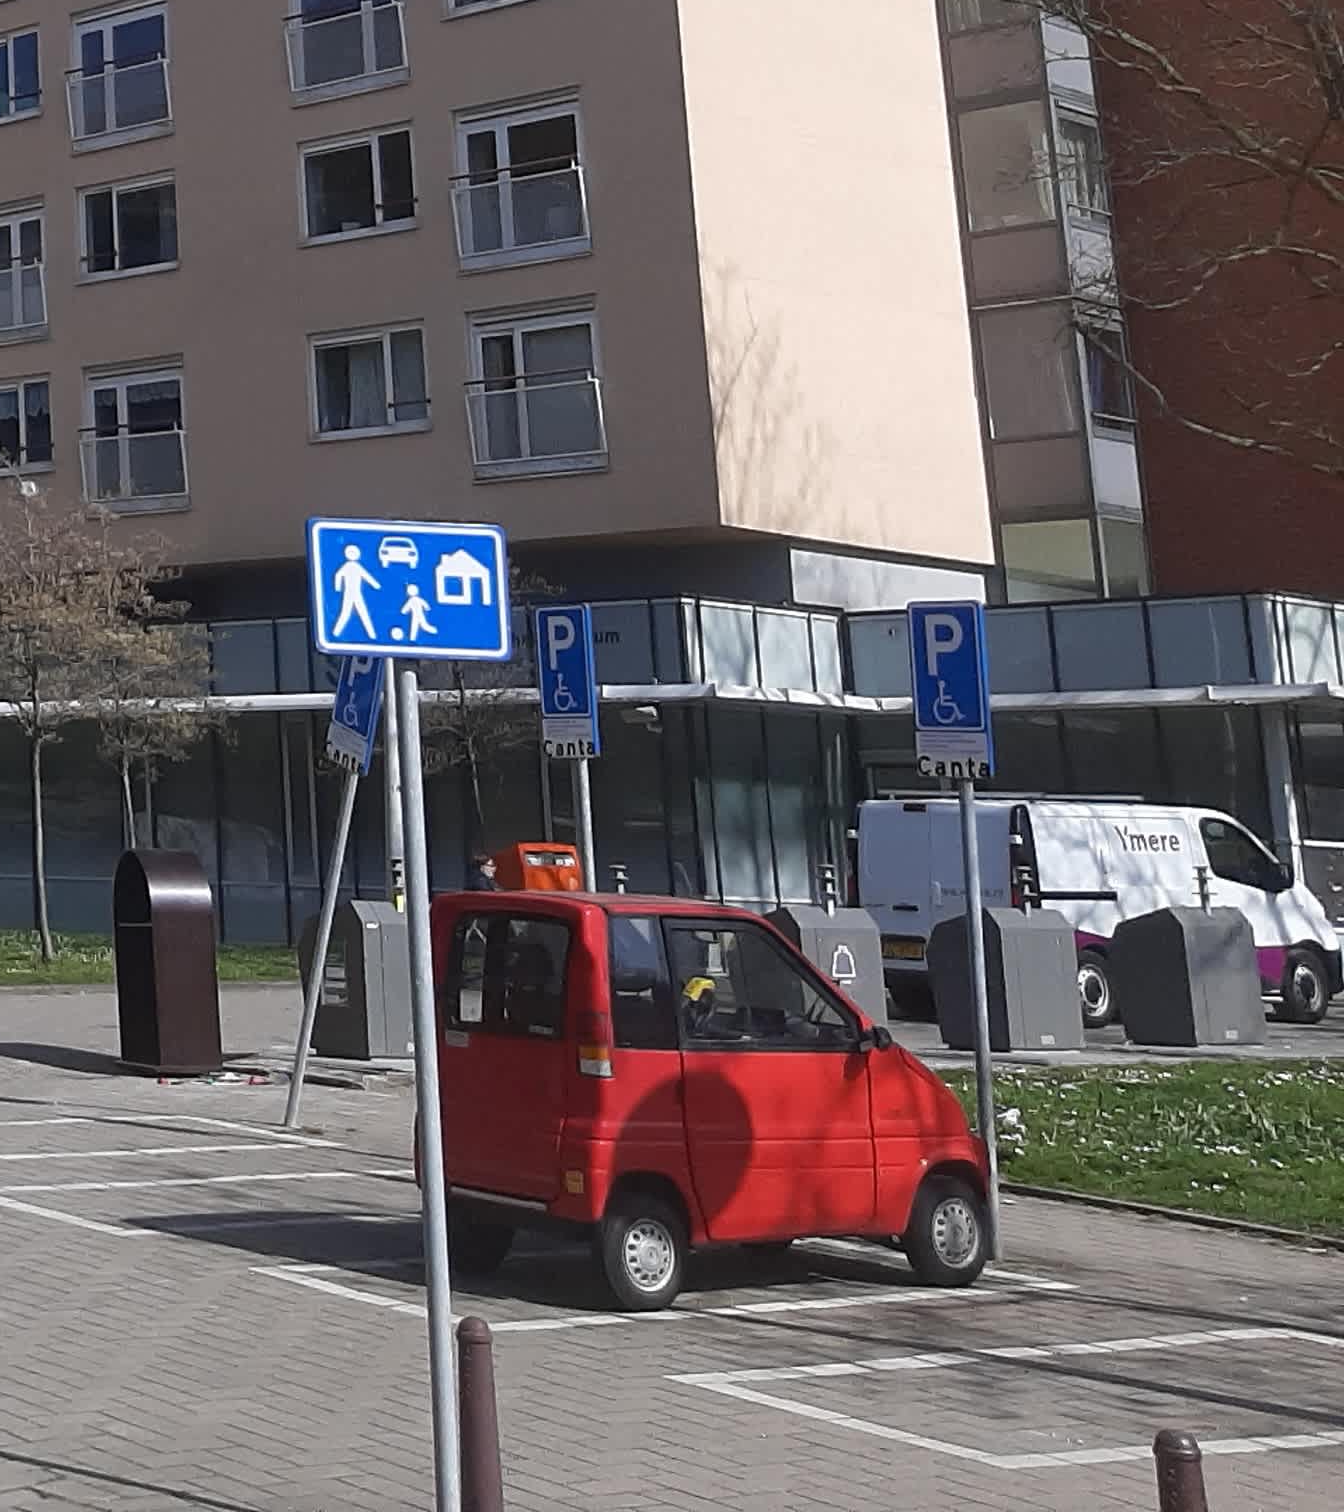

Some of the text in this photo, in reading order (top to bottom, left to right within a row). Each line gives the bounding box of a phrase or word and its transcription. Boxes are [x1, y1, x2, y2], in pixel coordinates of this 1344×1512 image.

[547, 615, 575, 671] P
[925, 614, 963, 676] P
[543, 739, 596, 757] Canta
[918, 755, 991, 777] Canta
[1114, 825, 1181, 852] Ymere
